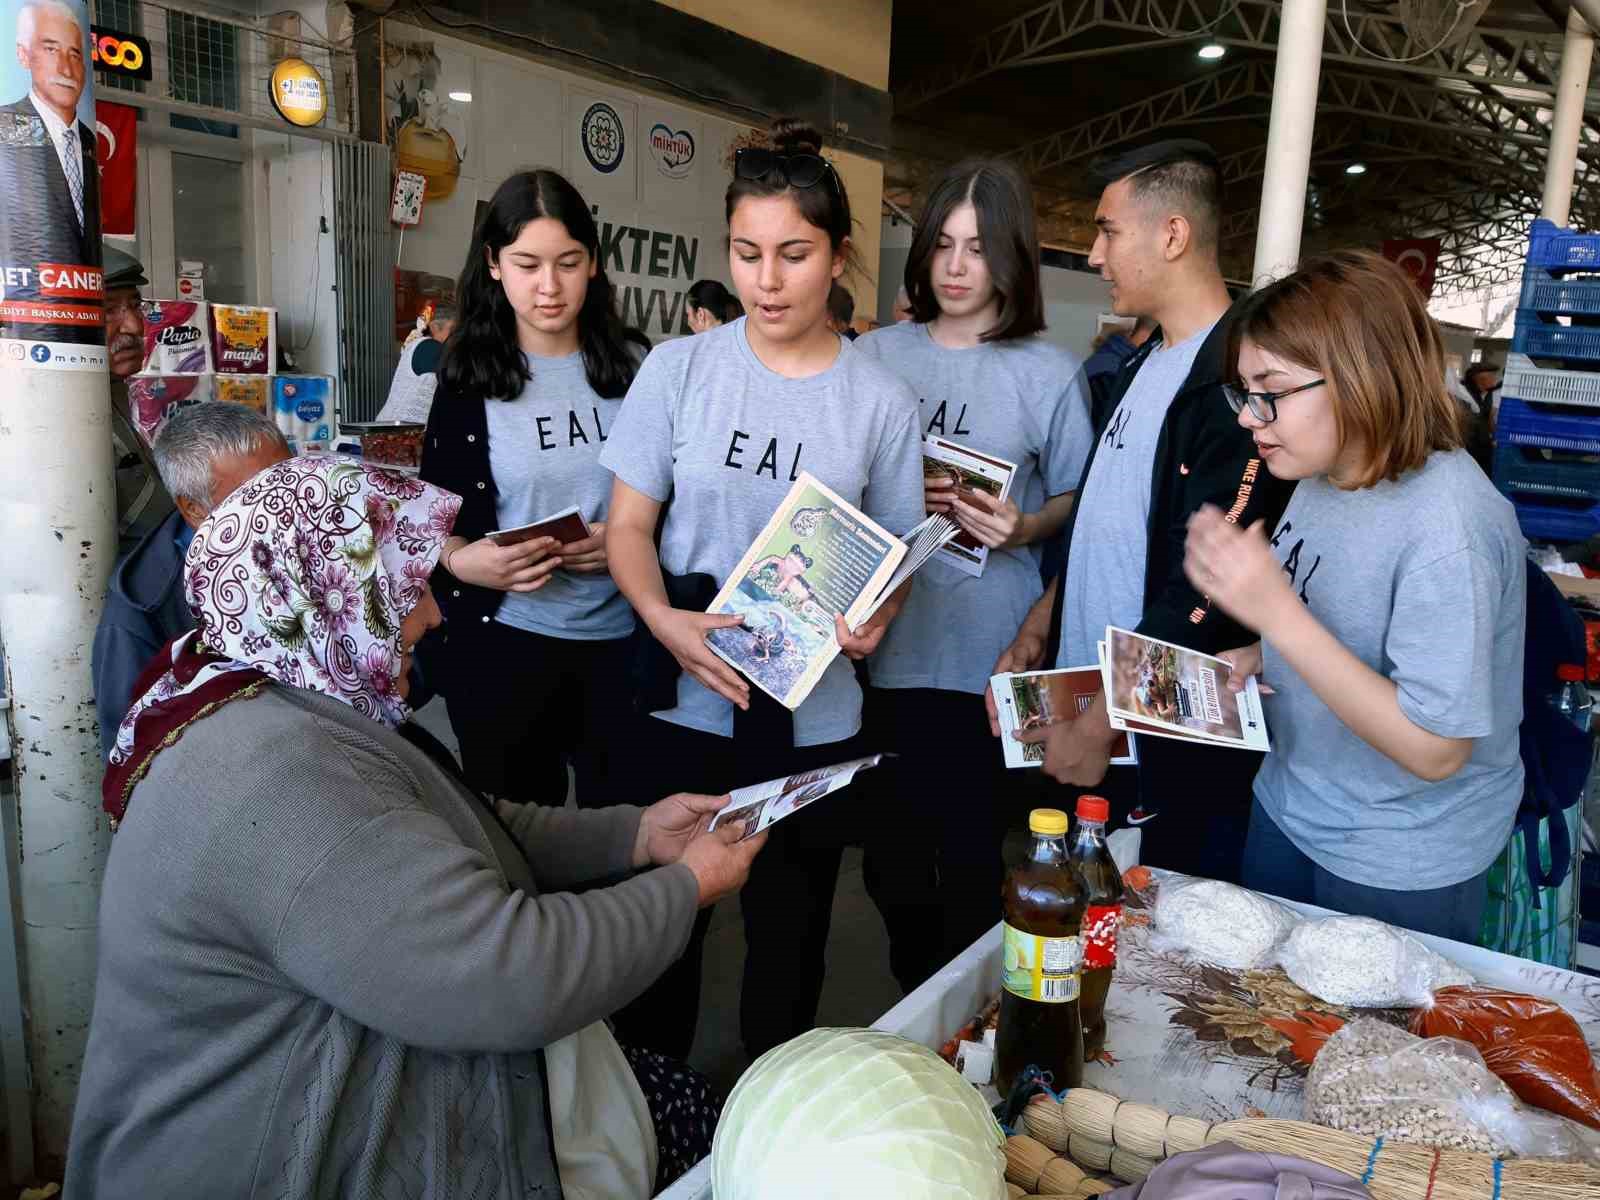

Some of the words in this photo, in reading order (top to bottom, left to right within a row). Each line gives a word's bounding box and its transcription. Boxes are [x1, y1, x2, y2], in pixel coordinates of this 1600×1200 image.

[0, 267, 32, 287] ET
[39, 268, 103, 292] CANER
[160, 325, 200, 345] Papia
[535, 406, 608, 451] EAL
[919, 398, 971, 442] AL
[724, 429, 804, 483] EAL
[1242, 458, 1261, 484] NIKE
[1224, 483, 1253, 524] RUNNING
